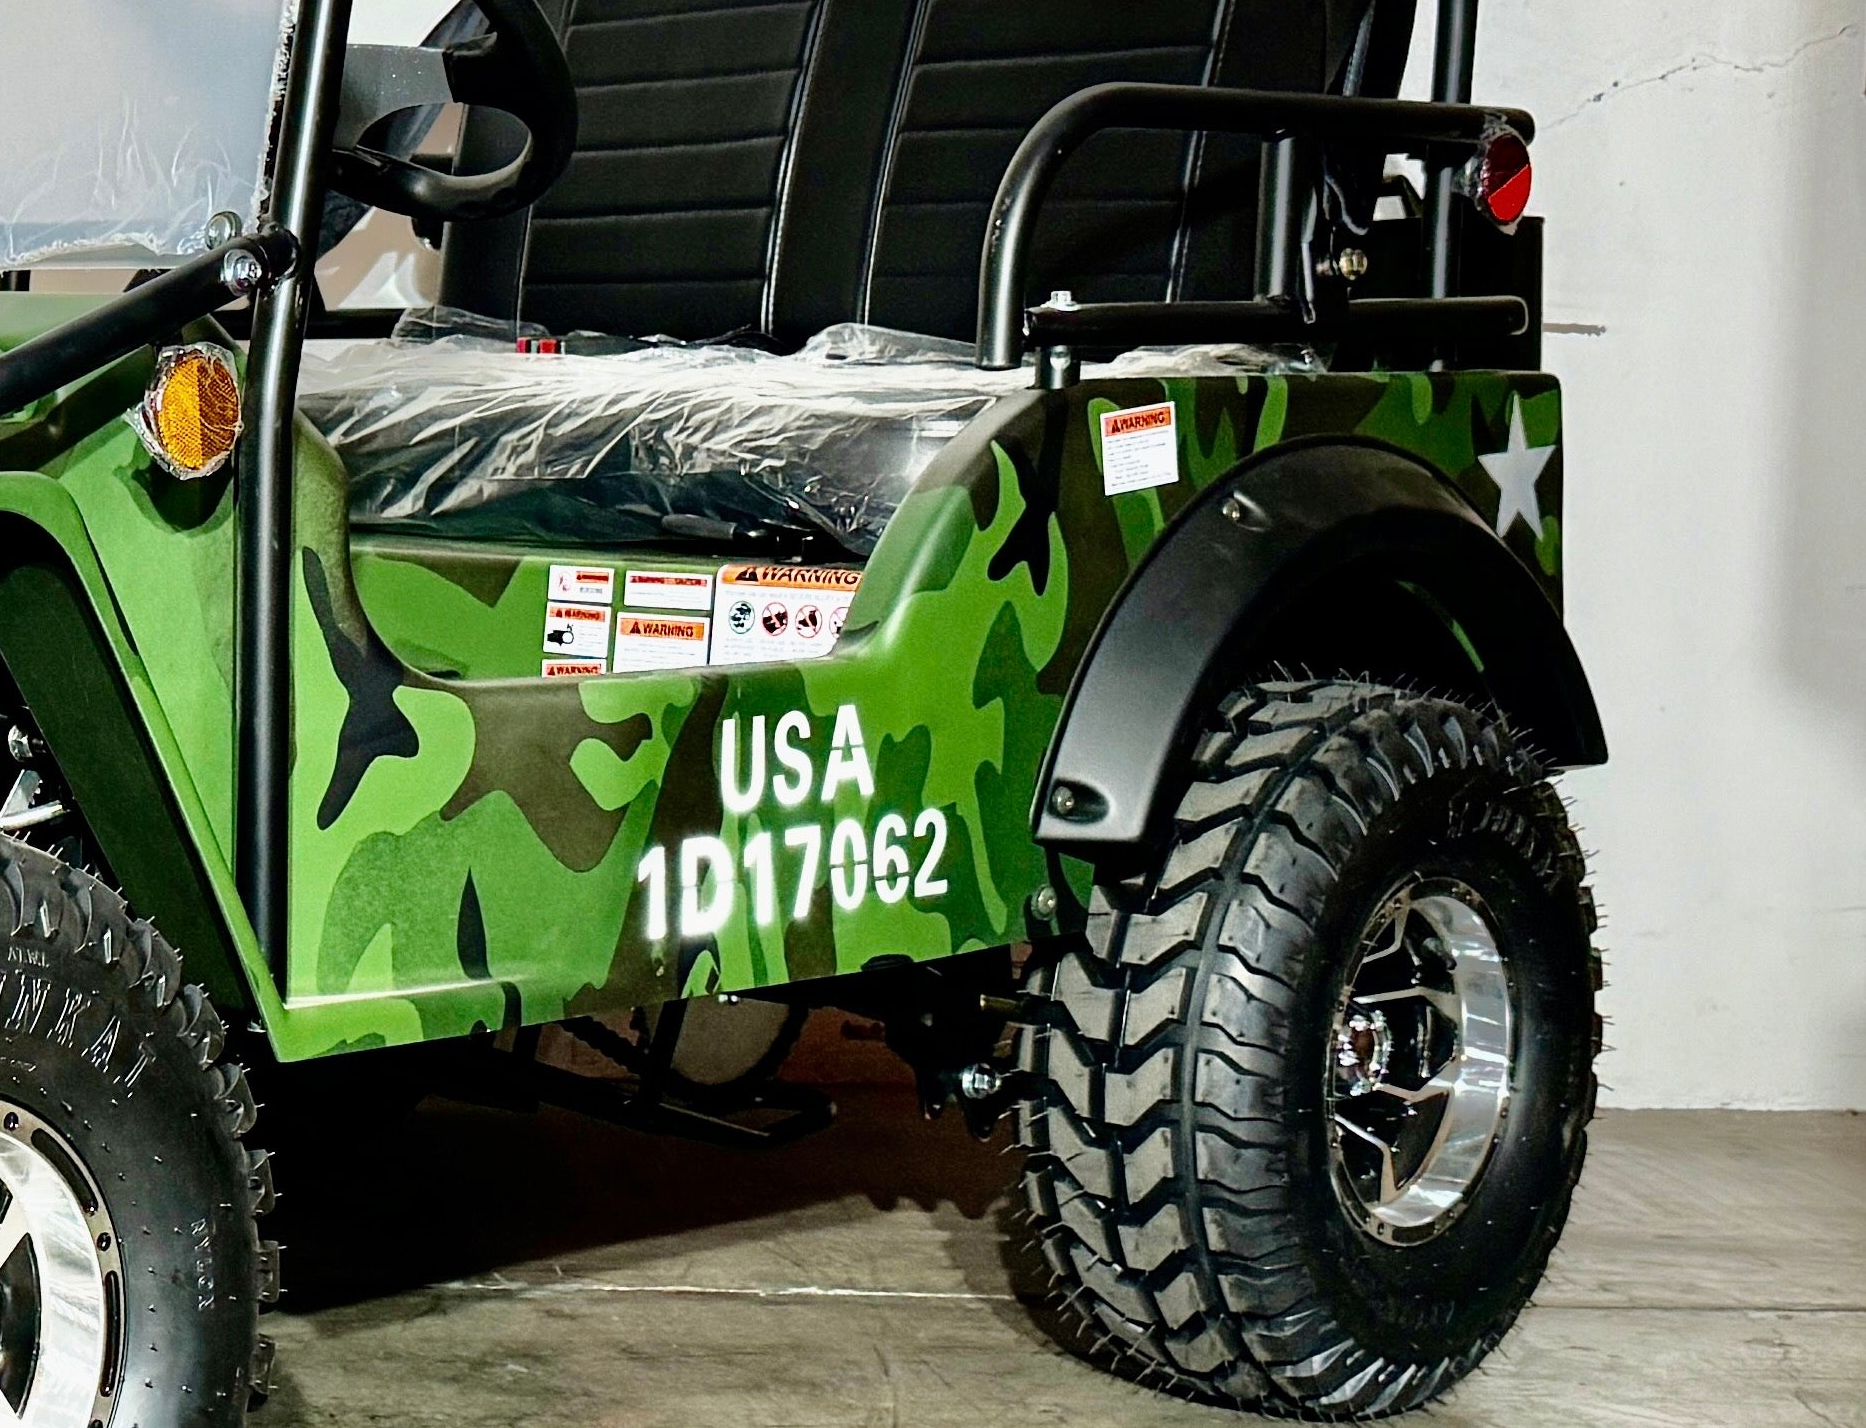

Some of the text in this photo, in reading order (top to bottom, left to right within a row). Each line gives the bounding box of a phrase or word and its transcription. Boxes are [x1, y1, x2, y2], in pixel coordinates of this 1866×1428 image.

[762, 566, 862, 586] WARNING
[642, 622, 695, 638] WARNING
[720, 704, 875, 813] USA
[636, 808, 949, 941] 1D17062
